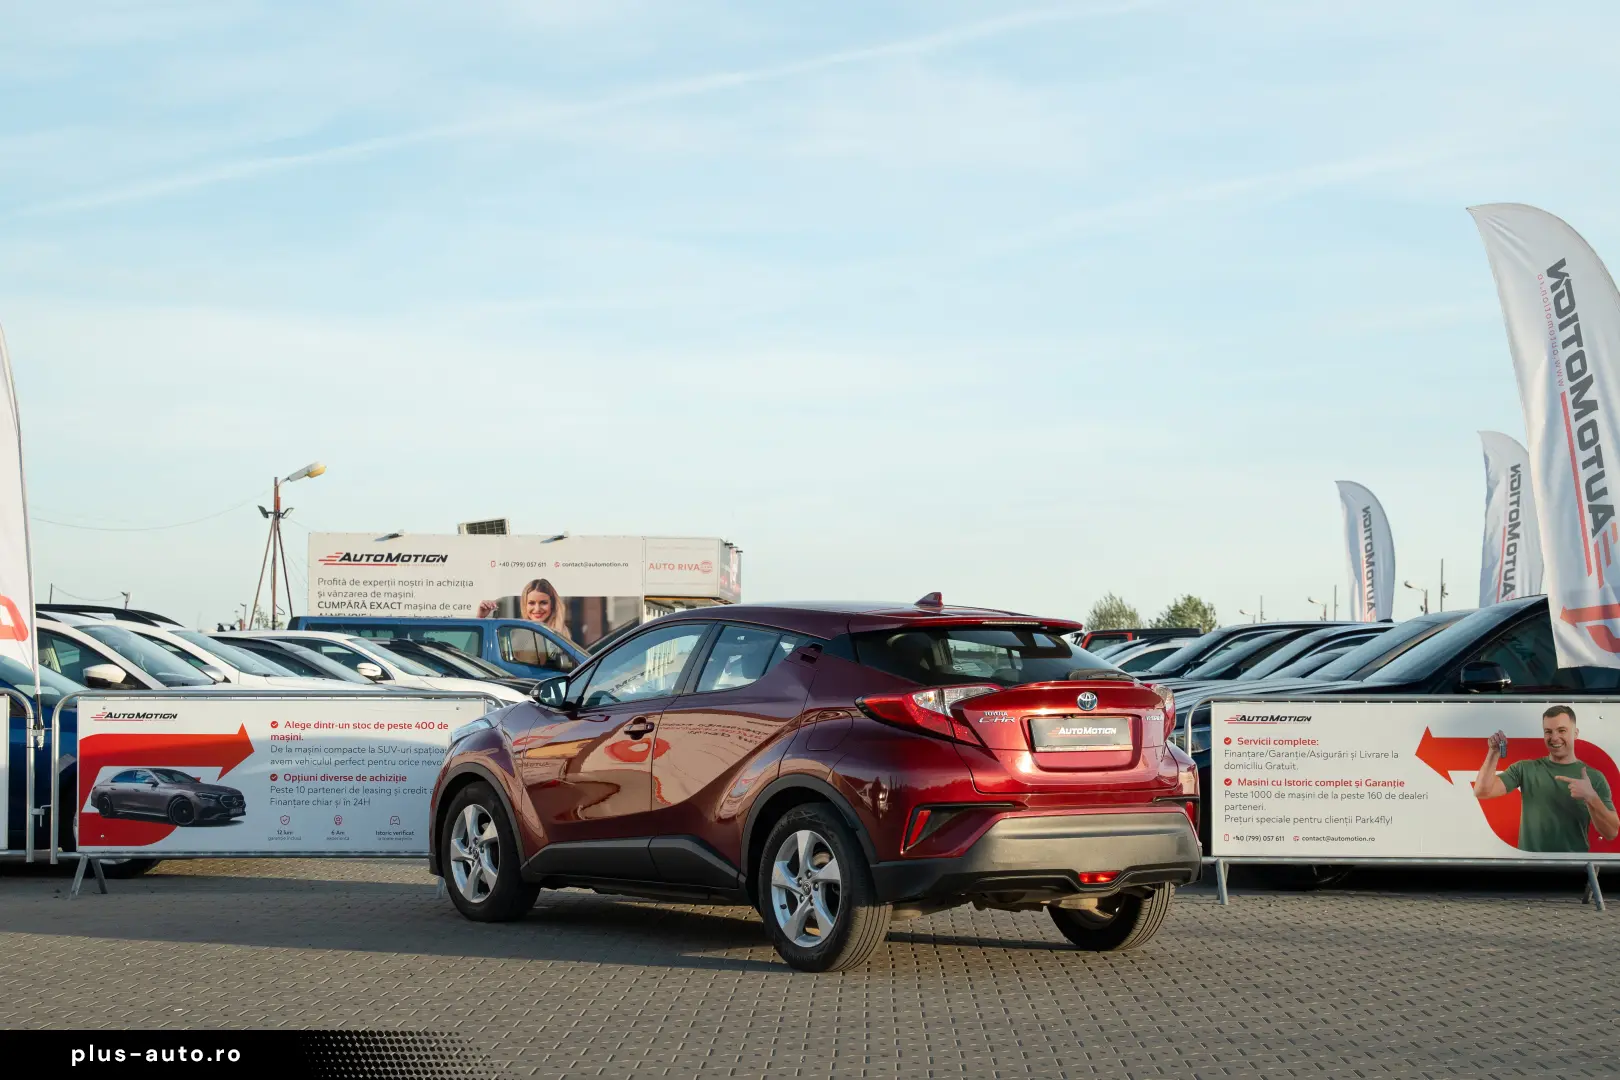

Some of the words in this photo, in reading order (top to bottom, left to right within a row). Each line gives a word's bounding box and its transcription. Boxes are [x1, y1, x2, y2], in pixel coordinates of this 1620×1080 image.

[648, 563, 676, 571] AUTO
[678, 563, 700, 571] RIVA
[349, 578, 361, 587] de
[398, 579, 424, 589] noștri
[317, 590, 326, 600] și
[370, 590, 382, 598] de
[369, 602, 403, 610] EXACT
[404, 602, 437, 612] mașina
[439, 602, 451, 610] de
[284, 720, 312, 730] Alege
[314, 720, 350, 729] dintr-un
[352, 722, 372, 730] stoc
[373, 721, 385, 730] de
[387, 722, 412, 731] peste
[414, 722, 435, 730] 400
[437, 722, 449, 730] de
[270, 732, 304, 742] mașini.
[1237, 737, 1271, 746] Servicii
[1273, 737, 1320, 748] complete:
[270, 744, 284, 753] De
[285, 744, 292, 753] la
[294, 745, 322, 756] mașini
[324, 746, 366, 755] compacte
[368, 745, 376, 754] la
[377, 746, 412, 754] SUV-uri
[1350, 750, 1357, 760] și
[1360, 750, 1390, 759] Livrare
[1391, 750, 1399, 759] la
[295, 757, 332, 766] vehiculul
[334, 758, 366, 767] perfect
[368, 758, 396, 768] pentru
[1224, 761, 1263, 770] domiciliu
[1265, 762, 1299, 770] Gratuit.
[284, 773, 318, 784] Opțiuni
[320, 774, 354, 782] diverse
[356, 774, 368, 782] de
[369, 774, 408, 784] achiziție
[1284, 778, 1313, 787] Istoric
[1314, 778, 1353, 789] complet
[1354, 778, 1362, 788] și
[1364, 778, 1406, 789] Garanție
[270, 786, 294, 794] Peste
[296, 786, 306, 794] 10
[308, 786, 347, 796] parteneri
[348, 786, 360, 794] de
[362, 786, 392, 796] leasing
[394, 786, 400, 796] și
[402, 786, 428, 794] credit
[1224, 790, 1248, 799] Peste
[1250, 790, 1272, 799] 1000
[1274, 790, 1286, 799] de
[1288, 791, 1316, 801] mașini
[1318, 791, 1329, 800] de
[1331, 791, 1339, 800] la
[1340, 792, 1365, 801] peste
[1367, 792, 1382, 800] 160
[1384, 792, 1396, 800] de
[1398, 792, 1429, 800] dealeri
[270, 797, 310, 808] Finanțare
[312, 798, 333, 806] chiar
[334, 798, 341, 808] și
[343, 798, 351, 806] în
[353, 798, 371, 806] 24H
[1224, 803, 1267, 812] parteneri.
[1224, 814, 1254, 826] Prețuri
[1256, 816, 1291, 825] speciale
[1292, 816, 1322, 826] pentru
[1324, 816, 1353, 826] clienții
[1355, 816, 1393, 826] Park4fly!
